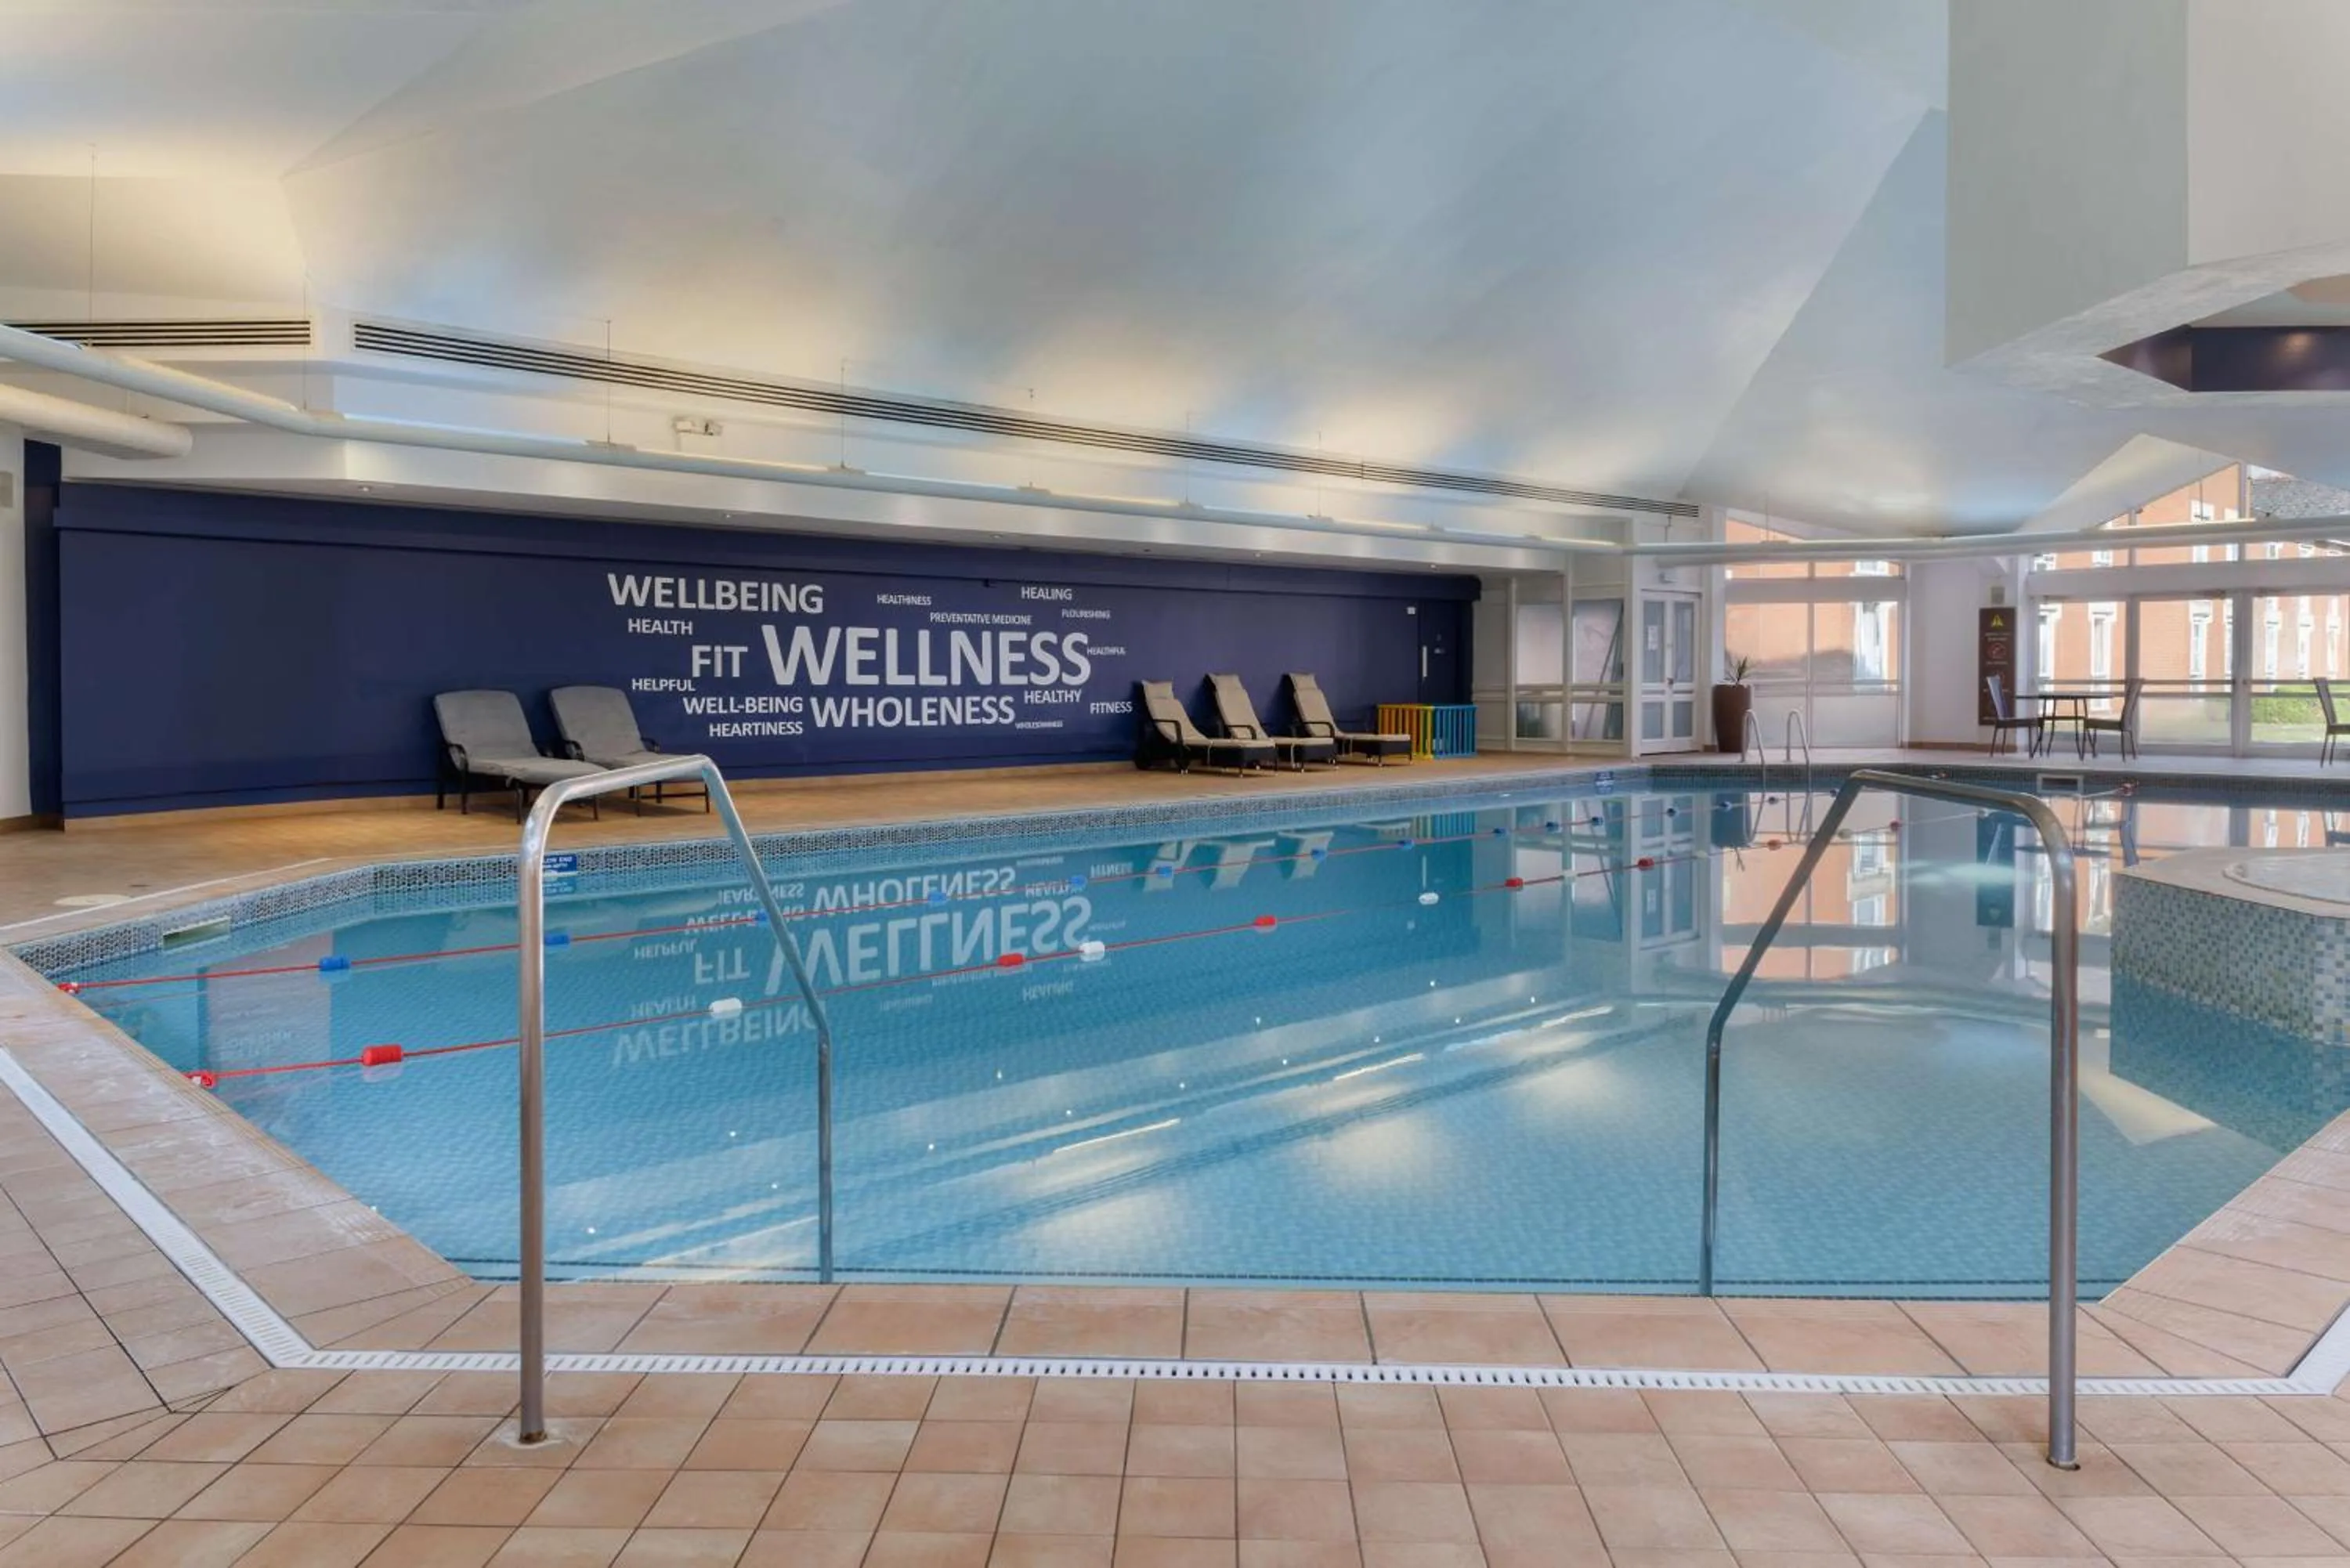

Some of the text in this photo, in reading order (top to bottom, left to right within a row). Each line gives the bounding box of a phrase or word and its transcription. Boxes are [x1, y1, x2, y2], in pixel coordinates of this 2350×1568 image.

[607, 573, 824, 614] WELLBEING
[877, 594, 931, 606] HEALTHINESS
[1021, 587, 1072, 601] HEALING
[628, 618, 693, 635] HEALTH
[930, 612, 1032, 626] PREVENTATIVE MEDICINE
[692, 645, 748, 677] FIT
[761, 624, 1091, 686] WELLNESS
[631, 678, 696, 692] HELPFUL
[682, 696, 804, 715] WELL-BEING
[1024, 689, 1082, 705] HEALTHY
[809, 696, 1015, 728] WHOLENESS
[1090, 702, 1133, 714] FITNESS
[709, 721, 803, 738] HEARTINESS
